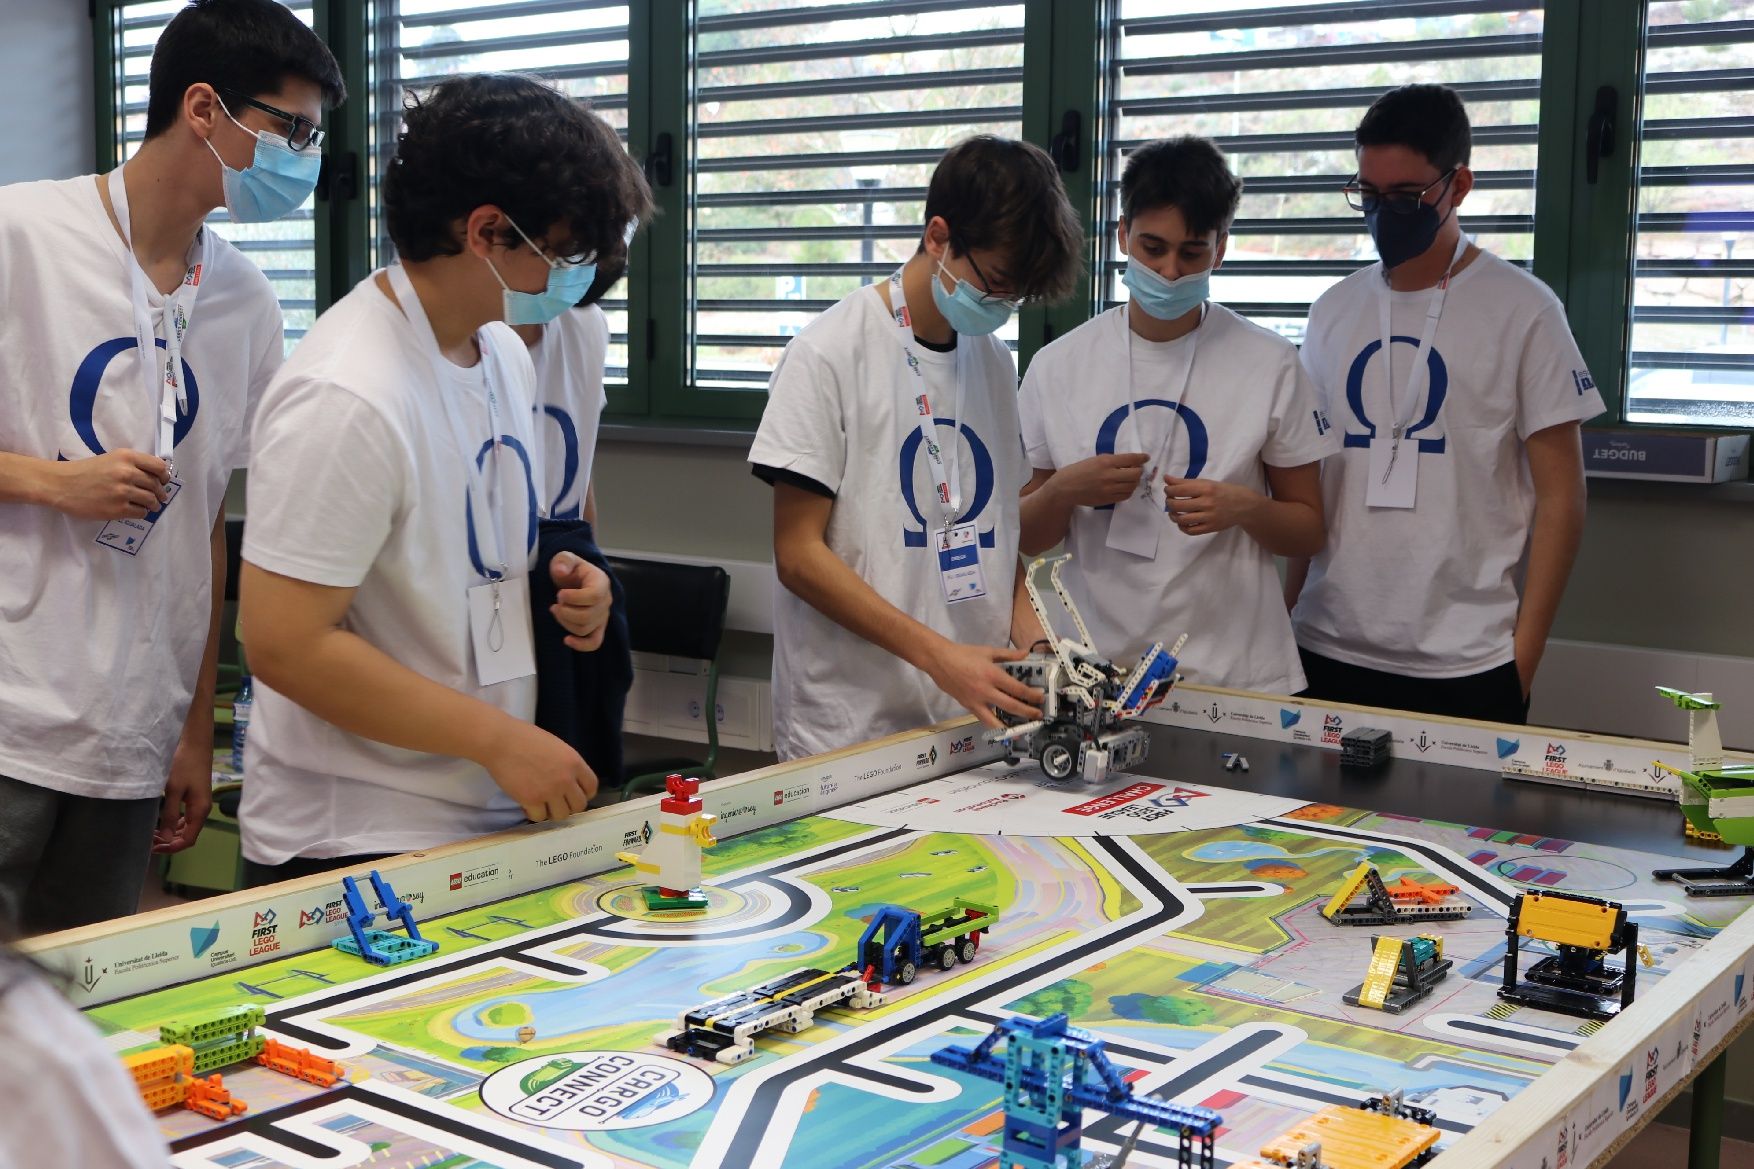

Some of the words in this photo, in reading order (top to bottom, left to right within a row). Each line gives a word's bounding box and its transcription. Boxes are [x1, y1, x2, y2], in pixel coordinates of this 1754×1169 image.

[1593, 448, 1646, 461] BUDGET
[1323, 725, 1343, 733] FIRST
[1544, 755, 1568, 763] FIRST
[1546, 761, 1564, 769] LEGO
[863, 770, 878, 780] LEGO
[784, 786, 810, 799] education
[1076, 785, 1152, 813] CHALLENGE
[624, 829, 638, 838] FIRST
[536, 858, 548, 868] The
[548, 852, 569, 865] LEGO
[569, 844, 603, 859] Foundation
[463, 867, 499, 883] education
[325, 899, 344, 909] FIRST
[325, 907, 342, 917] LEGO
[325, 911, 349, 923] LEAGUE
[252, 924, 278, 939] FIRST
[253, 934, 275, 947] LEGO
[249, 942, 281, 956] LEAGUE
[524, 1055, 635, 1116] CONNECT
[578, 1070, 666, 1117] CARGO
